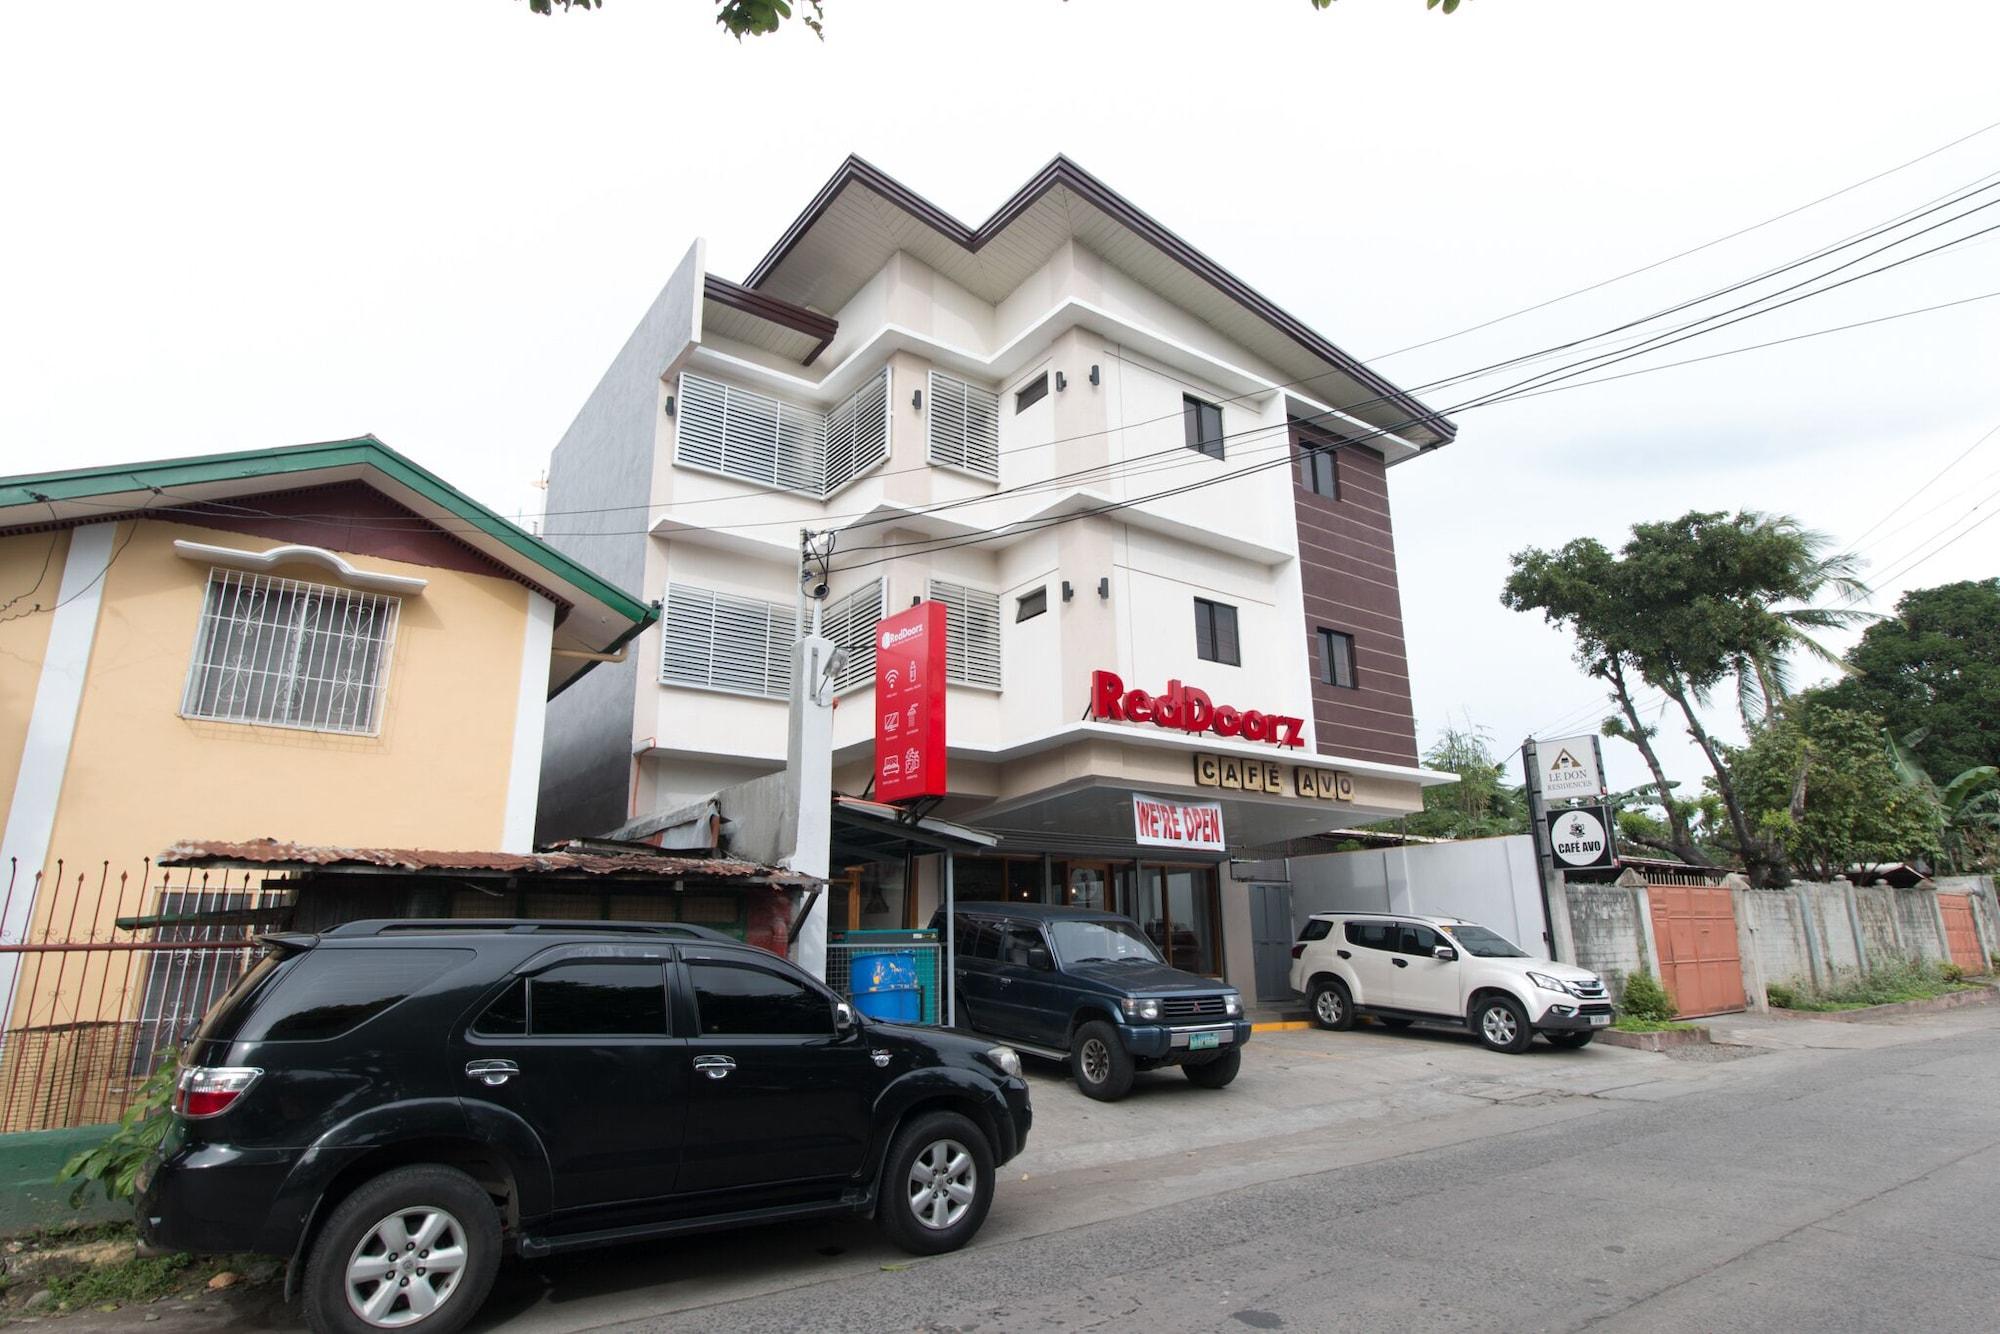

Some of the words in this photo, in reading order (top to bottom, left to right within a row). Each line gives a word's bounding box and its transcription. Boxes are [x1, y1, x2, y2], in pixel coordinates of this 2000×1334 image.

[890, 624, 923, 643] RedDoorz
[1091, 670, 1305, 747] RedDoorz
[1202, 760, 1281, 787] CAFÉ
[1302, 773, 1351, 795] AVO
[1549, 771, 1562, 783] LE
[1564, 769, 1587, 781] DON
[1547, 780, 1593, 792] RESIDENCES
[1136, 801, 1181, 840] WE'RE
[1183, 806, 1221, 843] OPEN
[1582, 840, 1601, 852] AVO
